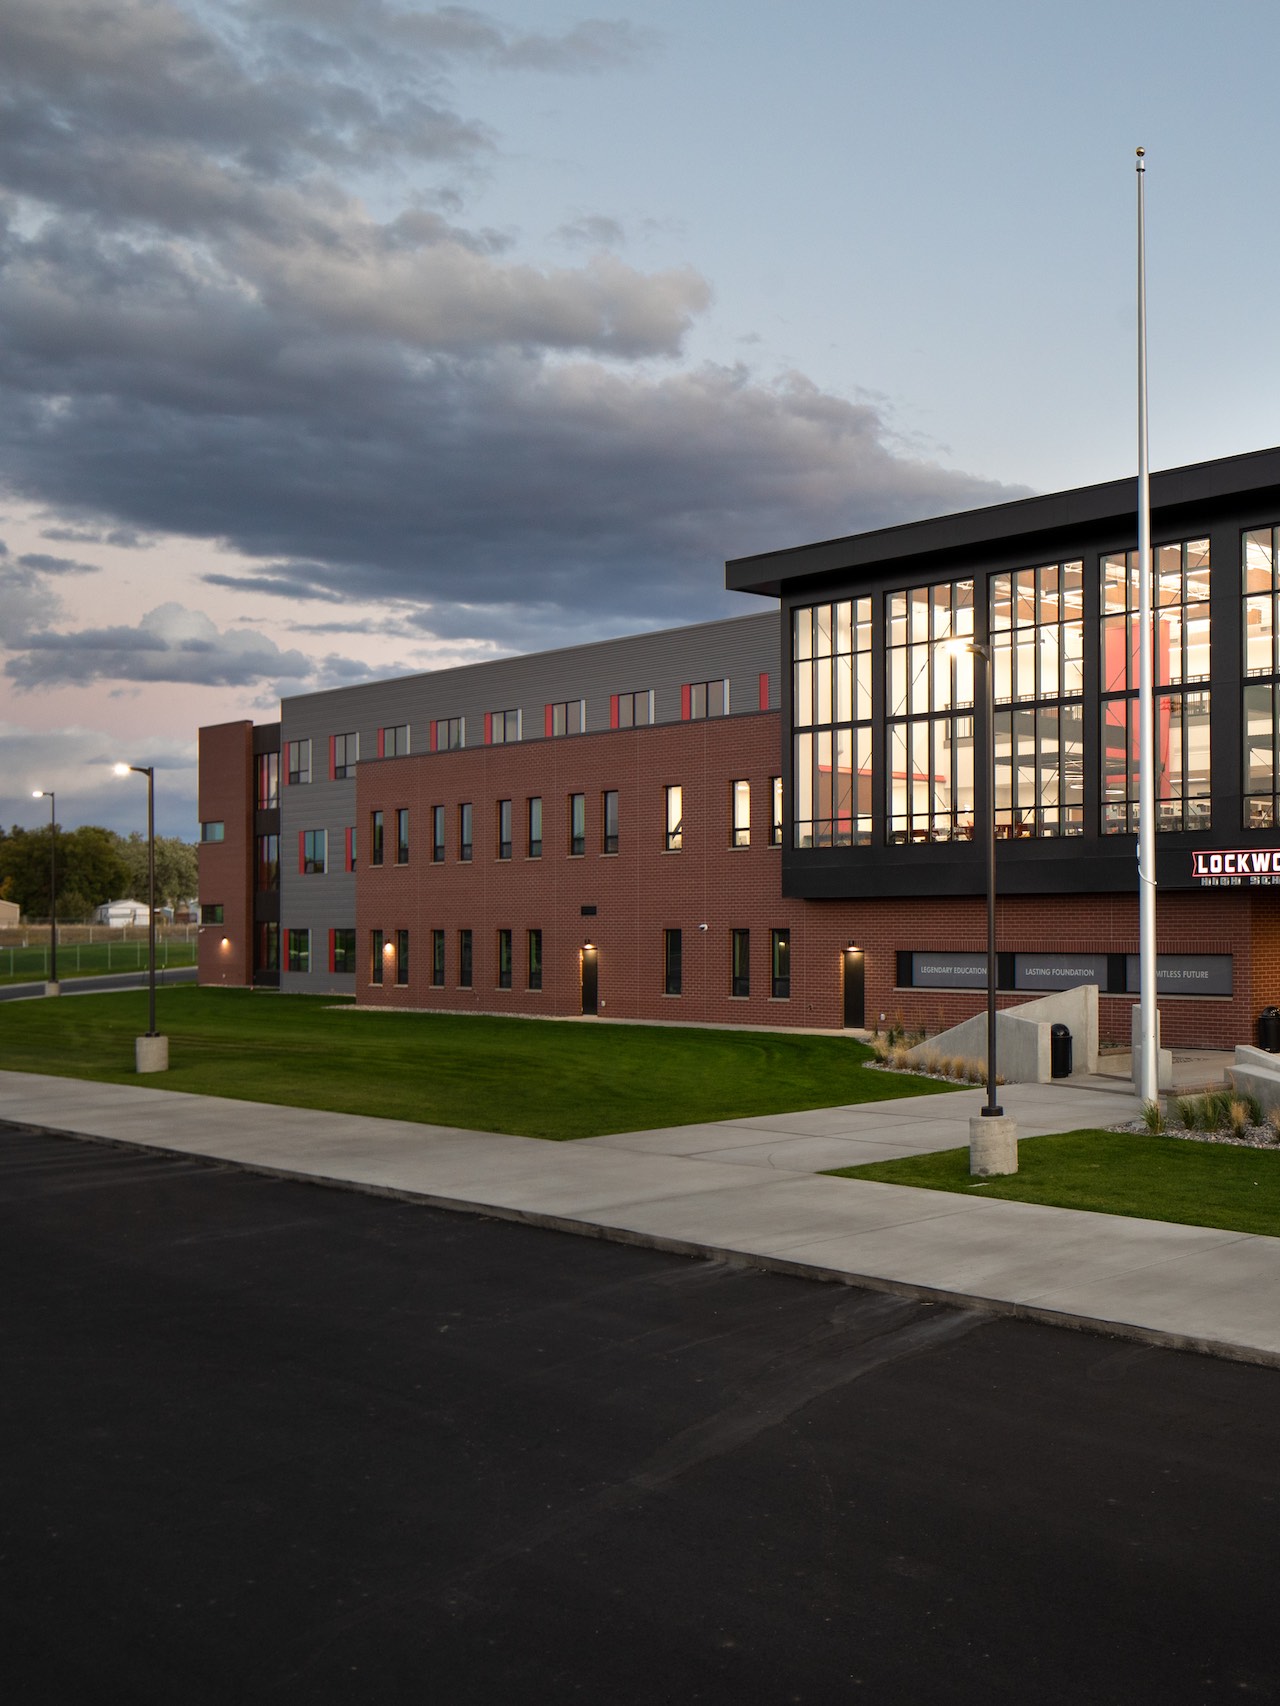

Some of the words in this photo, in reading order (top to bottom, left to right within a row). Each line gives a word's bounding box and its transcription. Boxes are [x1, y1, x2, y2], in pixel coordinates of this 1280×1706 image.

[1201, 877, 1241, 886] HIGH
[921, 966, 953, 974] LEGENDARY
[954, 967, 987, 975] EDUCATION
[1025, 968, 1051, 976] LASTING
[1052, 968, 1095, 977] FOUNDATION
[1182, 970, 1209, 979] FUTURE
